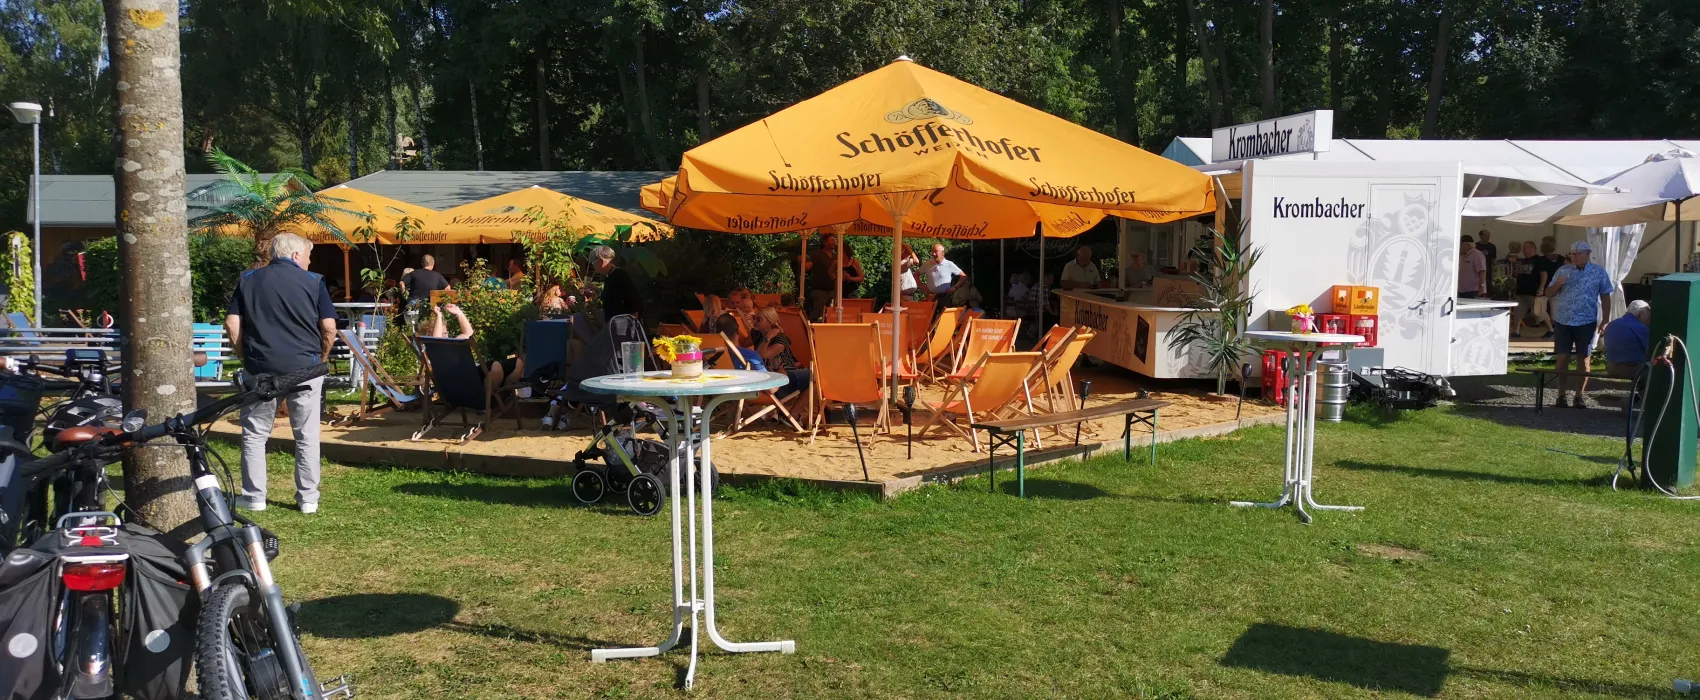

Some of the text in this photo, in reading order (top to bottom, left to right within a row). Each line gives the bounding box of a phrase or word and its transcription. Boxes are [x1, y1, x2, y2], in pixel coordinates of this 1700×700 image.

[836, 121, 1041, 162] Schöfferhofer
[1228, 121, 1292, 159] Krombacher
[768, 169, 881, 192] Schöfferhofer
[1029, 177, 1135, 205] Schöfferhofer
[445, 215, 534, 225] Schöfferhofe
[1273, 197, 1365, 218] Krombacher
[1075, 300, 1108, 332] Krombacher
